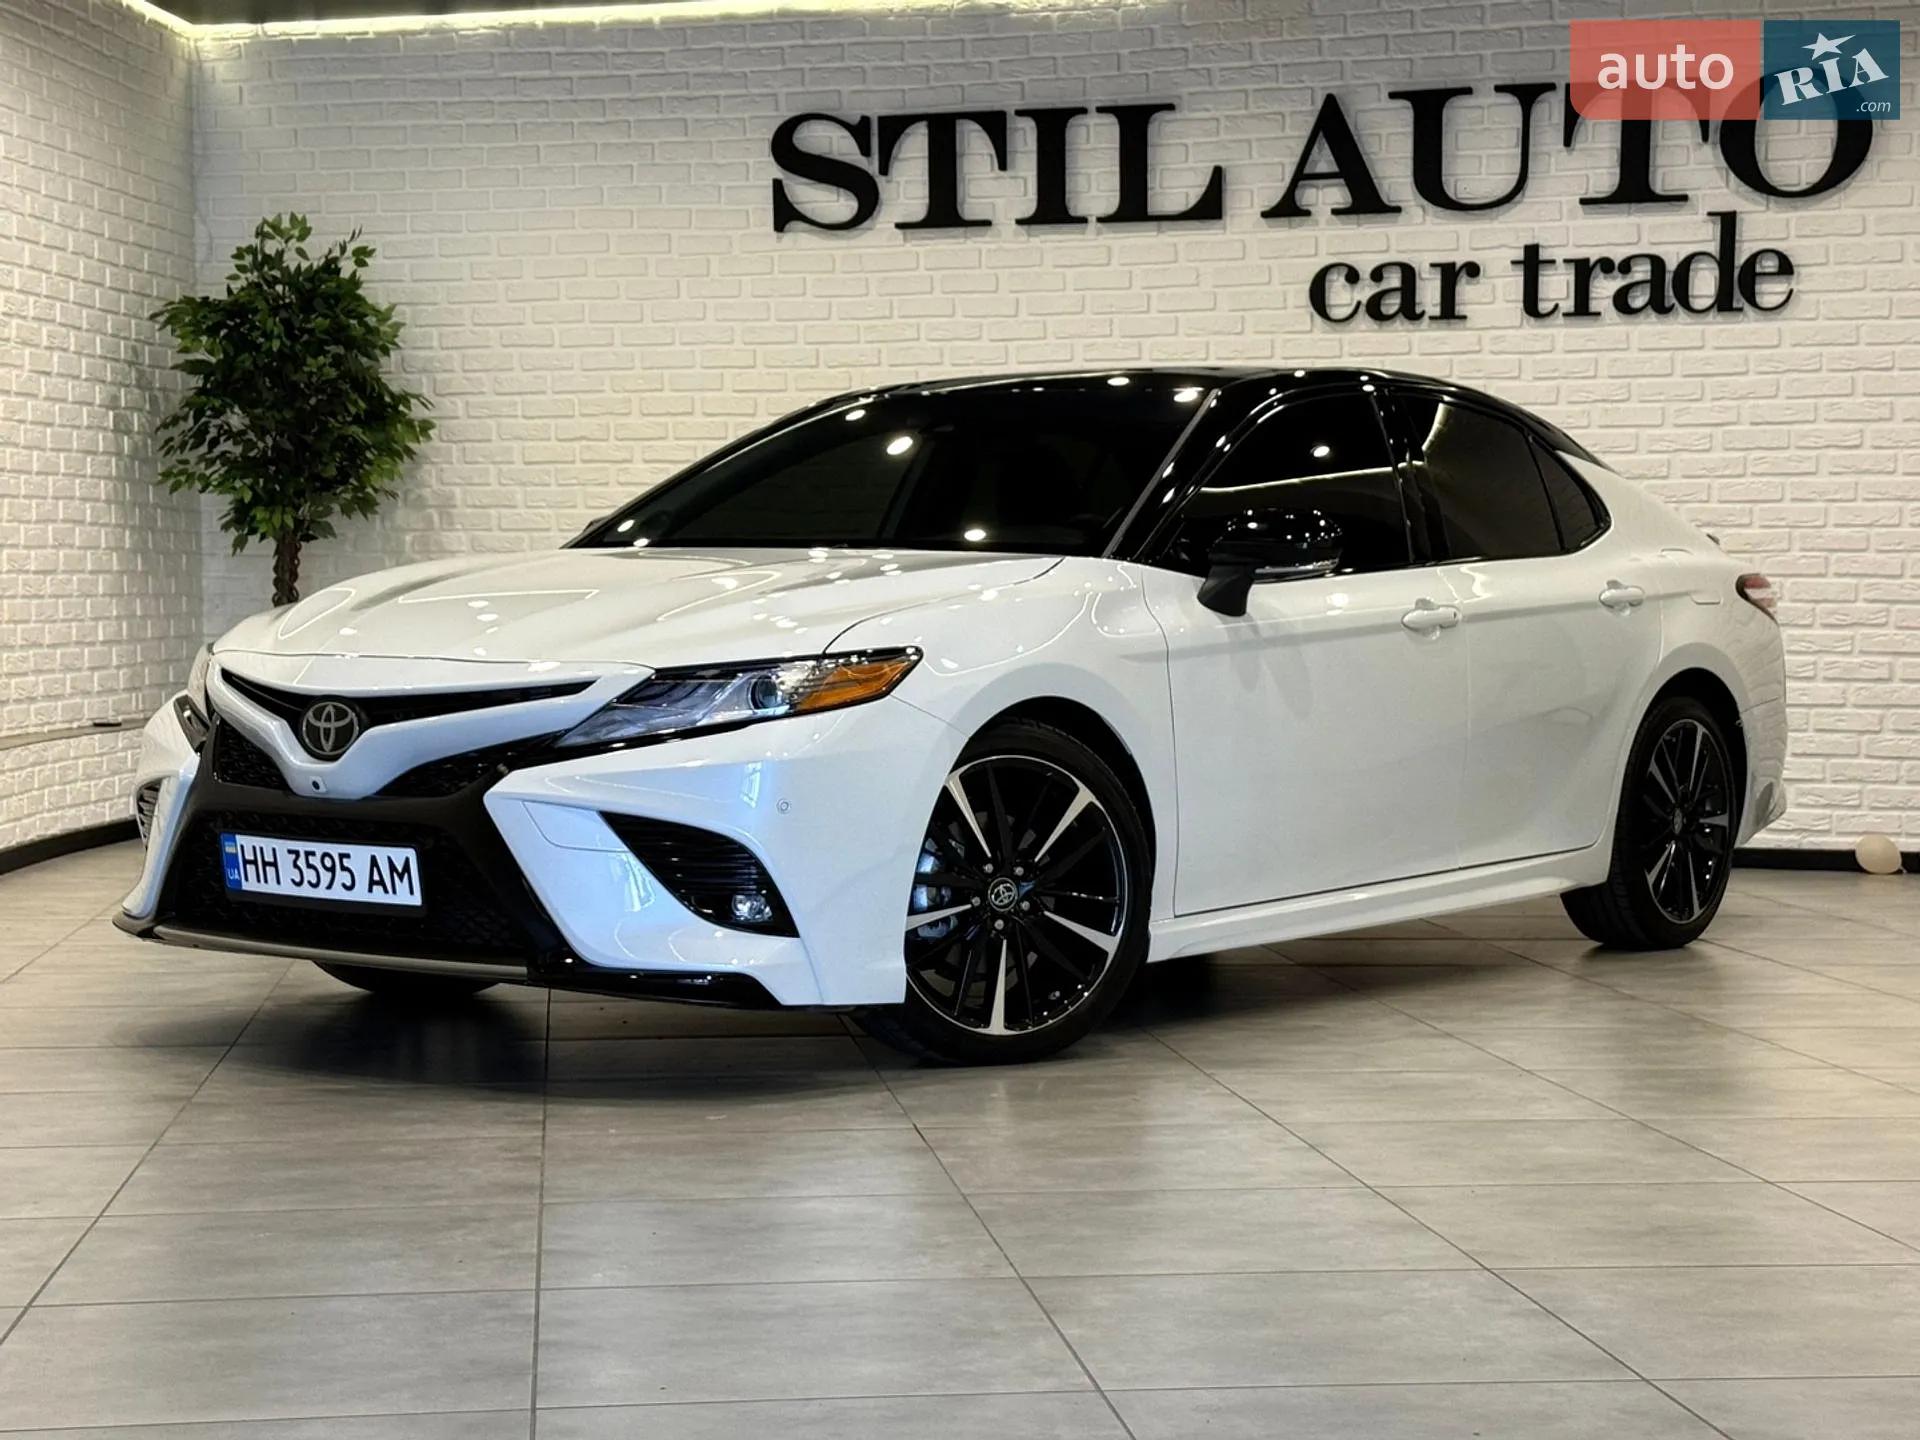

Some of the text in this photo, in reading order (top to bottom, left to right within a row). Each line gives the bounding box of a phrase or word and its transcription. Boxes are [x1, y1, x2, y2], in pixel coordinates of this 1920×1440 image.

[770, 69, 1874, 233] STIL AUTO
[1310, 210, 1795, 323] car trade
[227, 867, 240, 881] UA
[240, 844, 415, 896] HH 3595 AM
